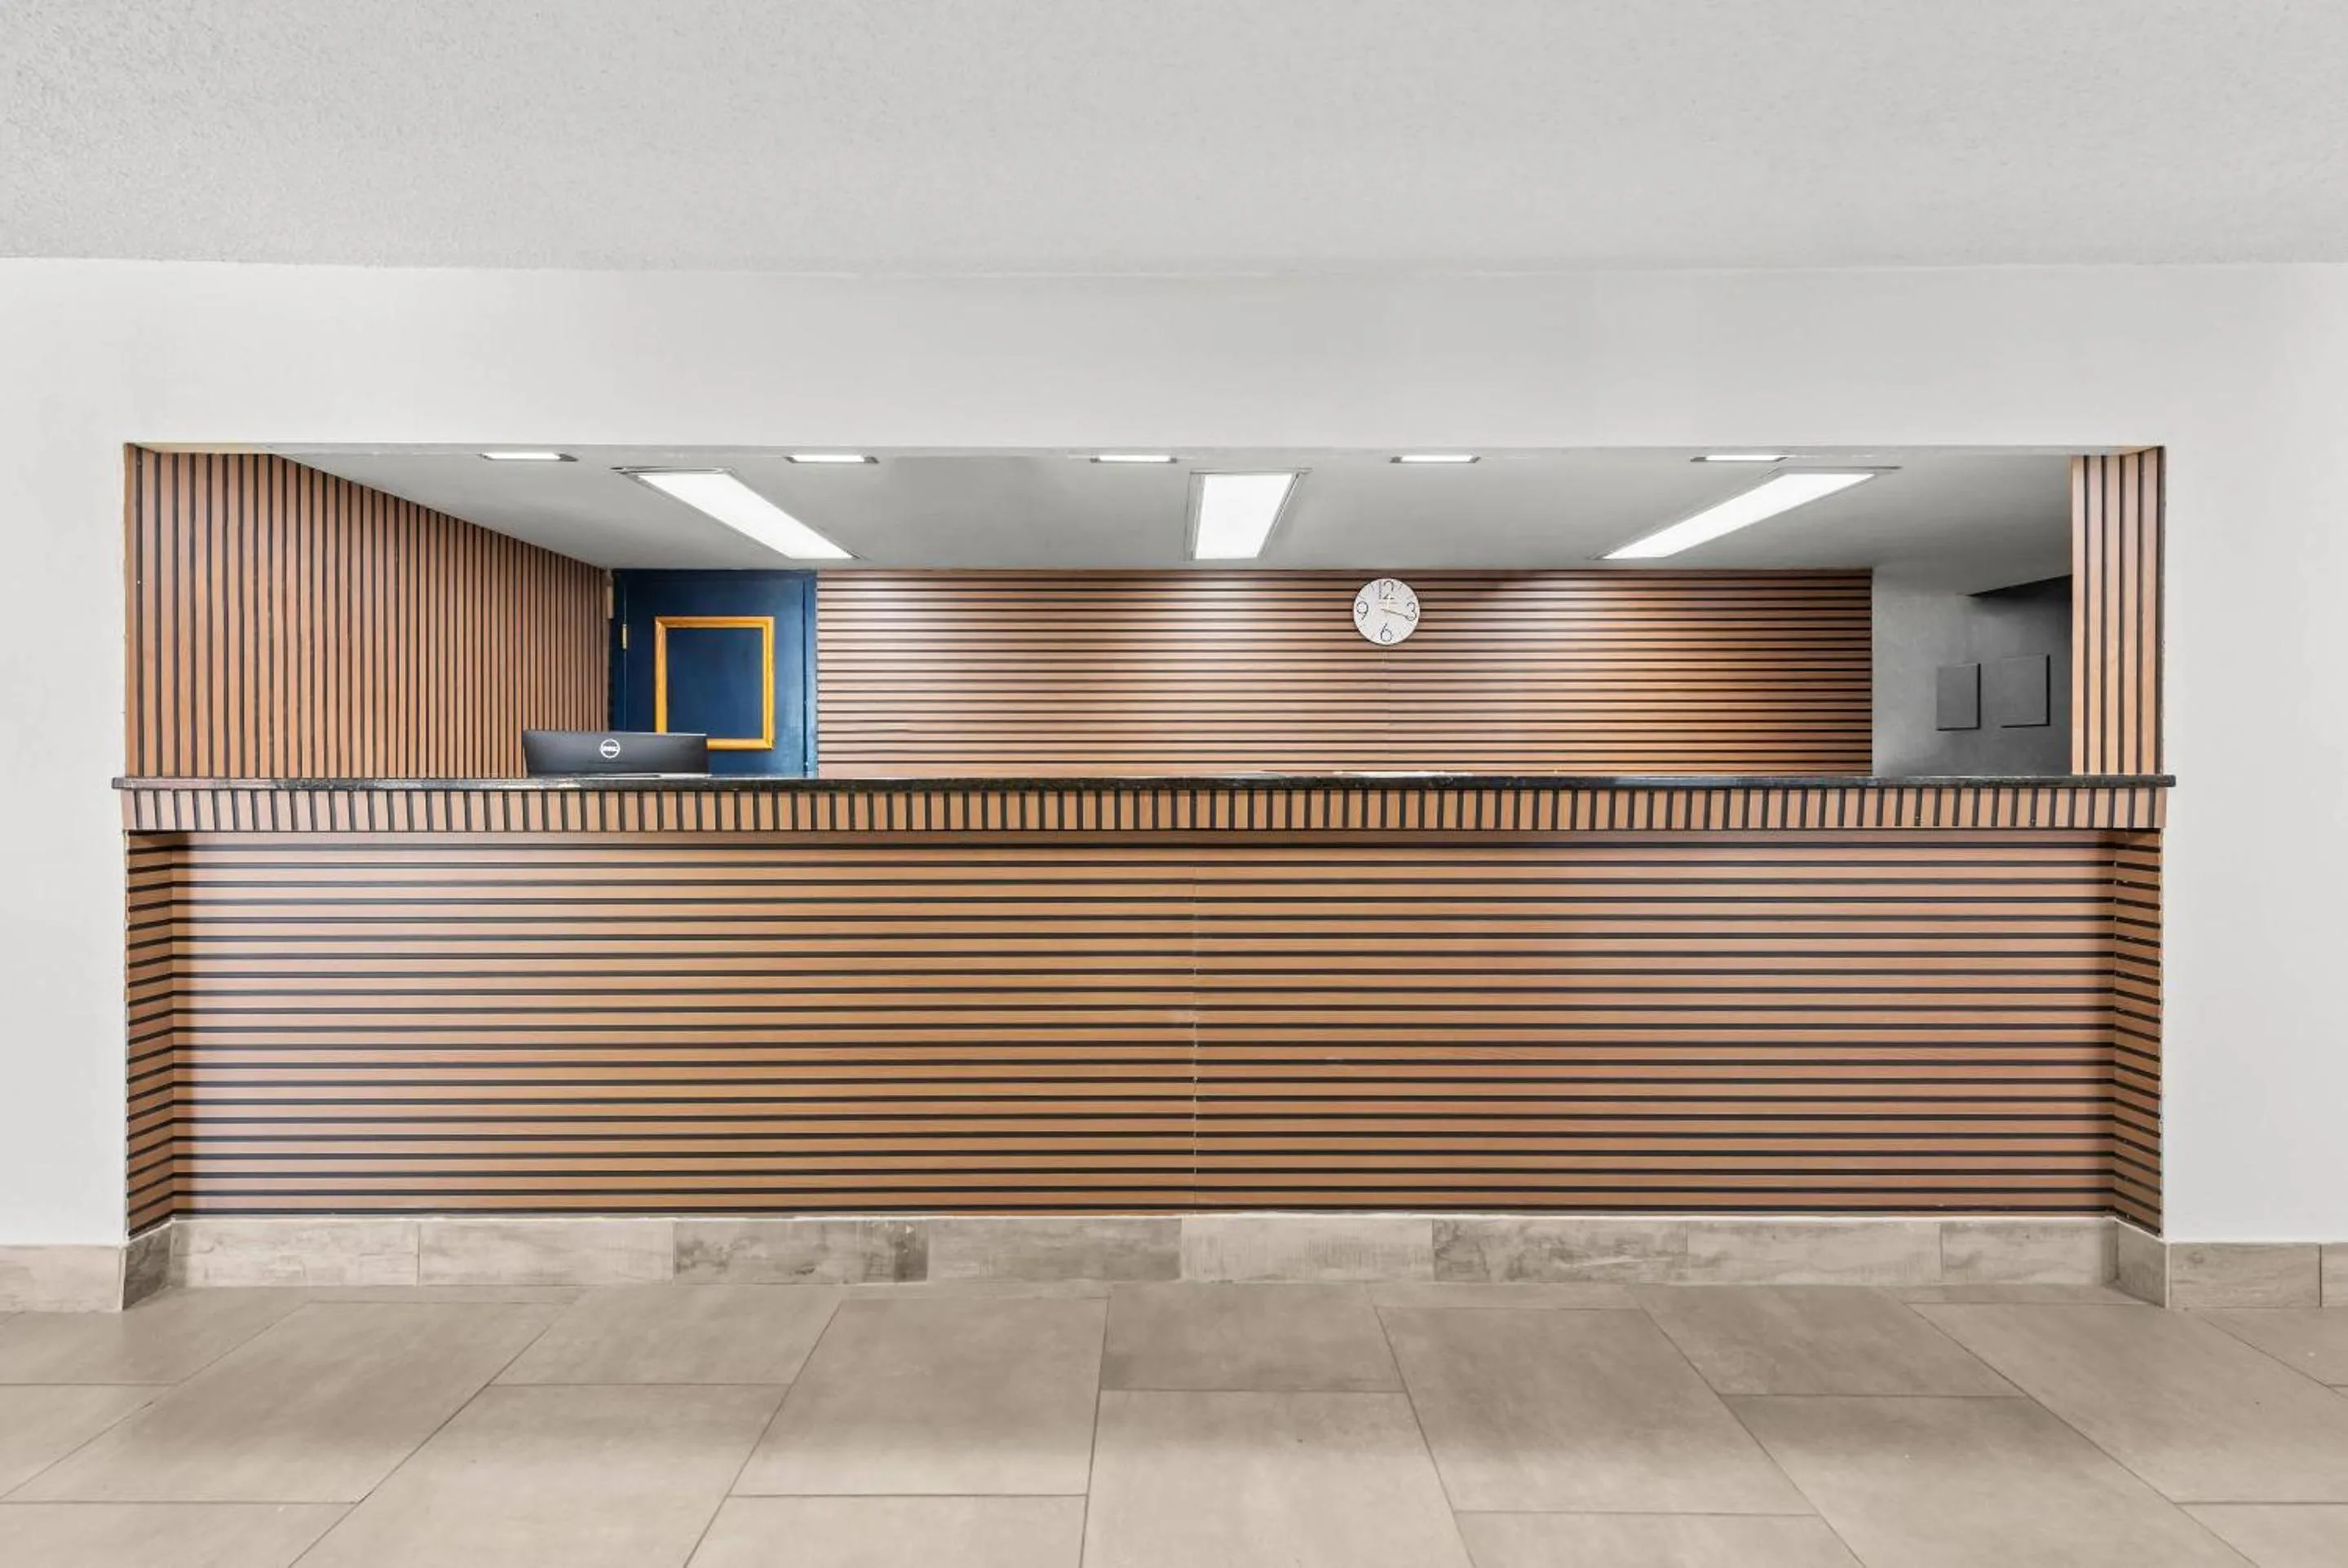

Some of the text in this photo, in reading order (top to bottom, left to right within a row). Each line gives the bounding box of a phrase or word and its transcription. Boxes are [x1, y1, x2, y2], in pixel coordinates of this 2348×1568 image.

[1378, 580, 1395, 599] 12
[1356, 601, 1369, 620] 9
[1406, 602, 1417, 621] 3
[1380, 623, 1392, 642] 6
